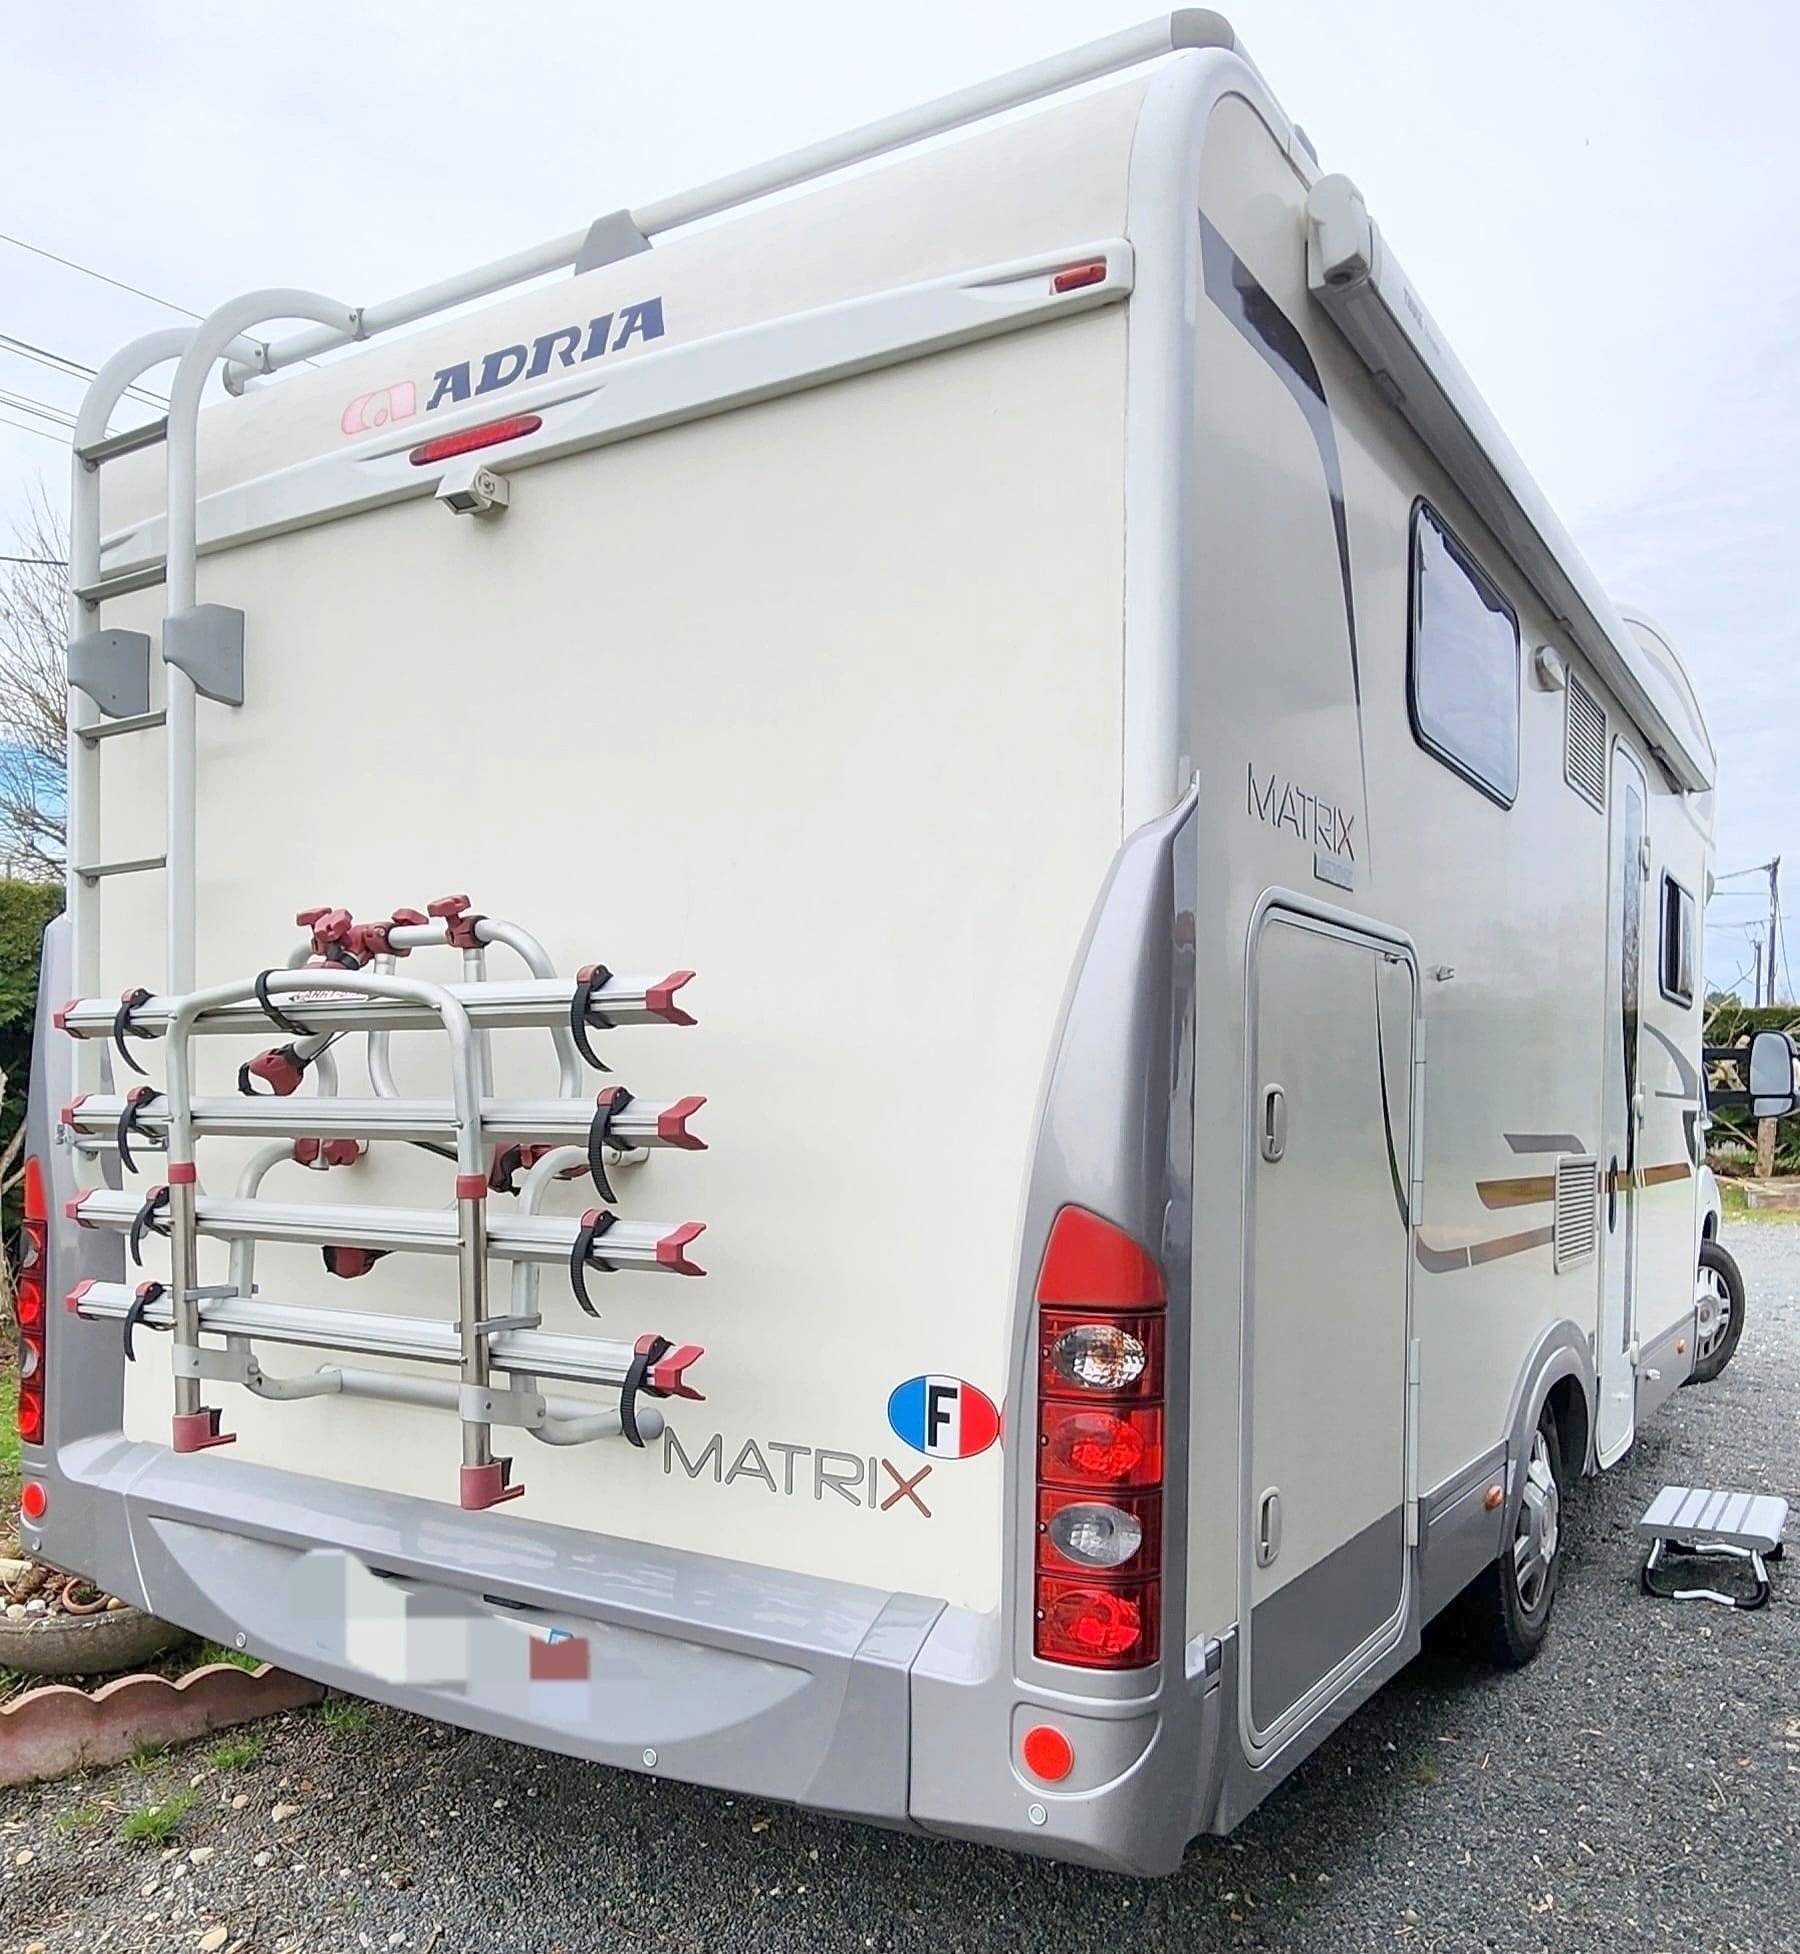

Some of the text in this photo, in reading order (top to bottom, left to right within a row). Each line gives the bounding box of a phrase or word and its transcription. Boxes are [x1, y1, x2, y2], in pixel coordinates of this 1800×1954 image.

[426, 296, 665, 411] ADRIA
[1247, 761, 1355, 862] MATRIX
[927, 1385, 958, 1448] F
[663, 1425, 933, 1518] MATRIX
